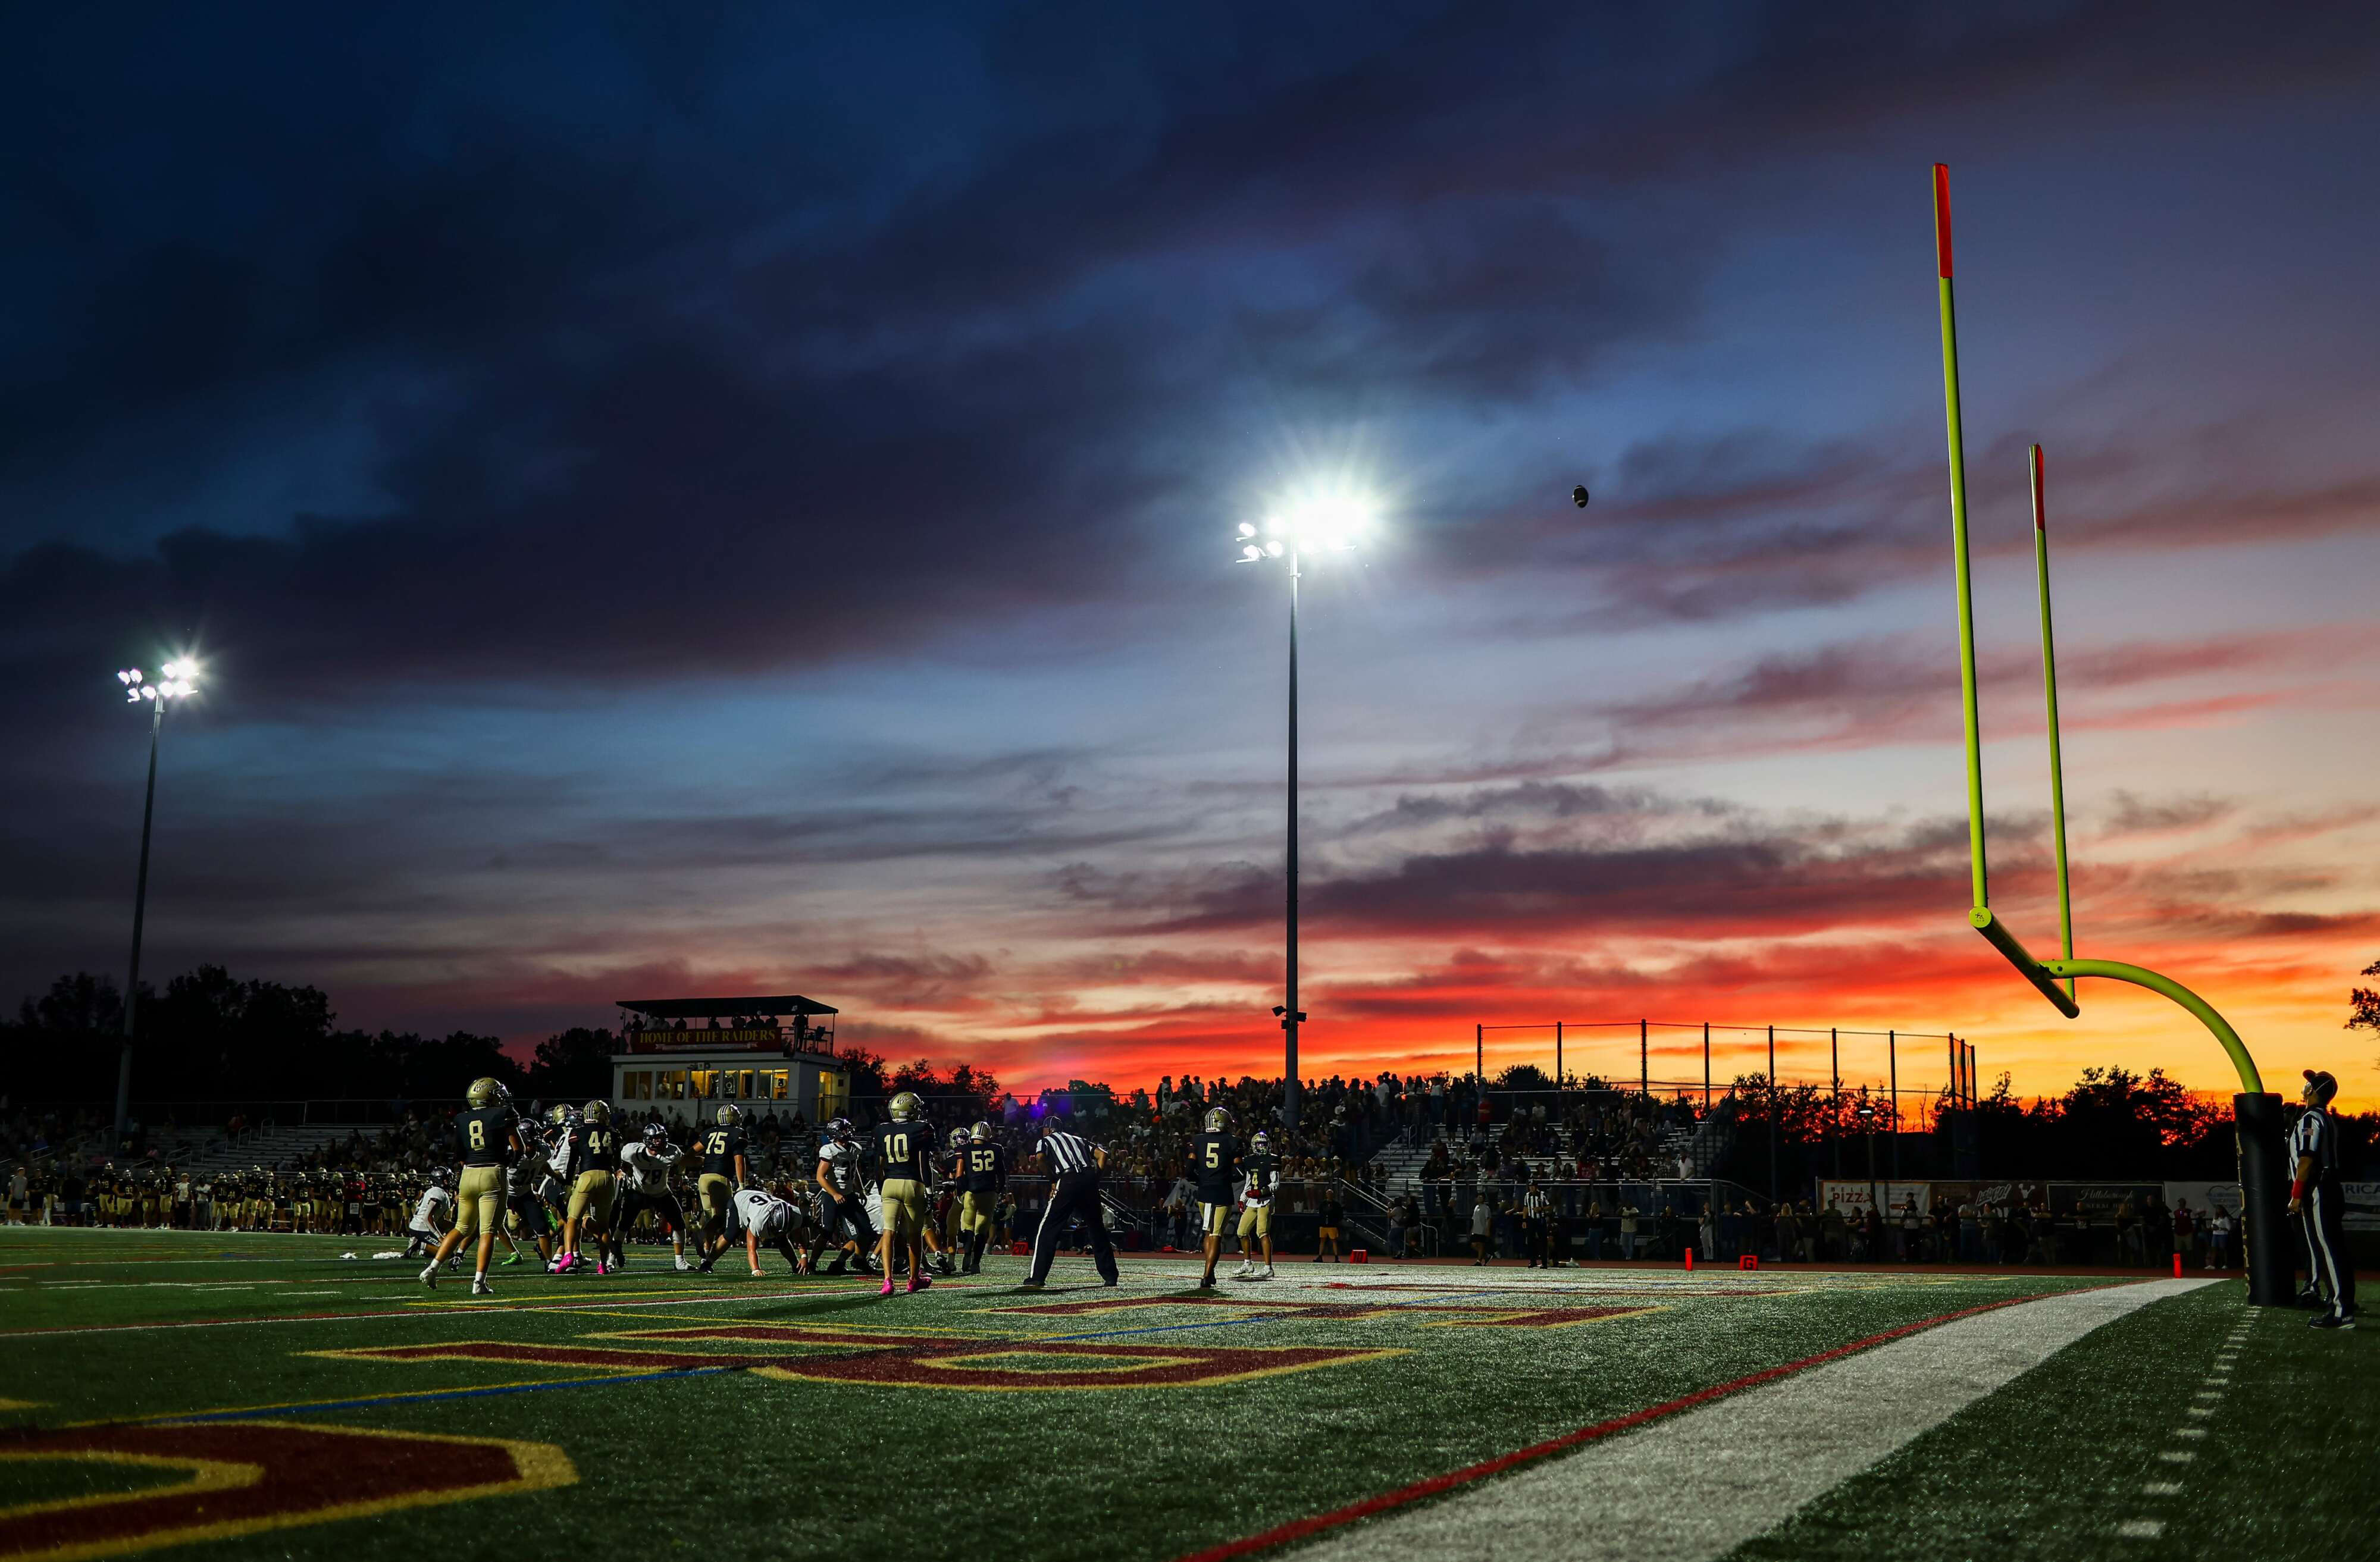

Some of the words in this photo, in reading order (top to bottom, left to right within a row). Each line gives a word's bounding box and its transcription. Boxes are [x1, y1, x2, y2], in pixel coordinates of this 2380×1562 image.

[640, 1032, 674, 1043] HOME
[677, 1032, 691, 1042] OF
[696, 1031, 719, 1042] THE
[722, 1030, 776, 1042] RAIDERS
[469, 1119, 486, 1151] 8
[588, 1131, 614, 1155] 44
[705, 1131, 729, 1155] 75
[884, 1133, 910, 1163] 10
[1205, 1142, 1220, 1169] 5
[971, 1150, 995, 1172] 52
[1251, 1172, 1259, 1190] 4
[367, 1190, 375, 1200] 91
[406, 1188, 415, 1197] 55
[1354, 1251, 1363, 1263] 10
[1744, 1257, 1754, 1270] G
